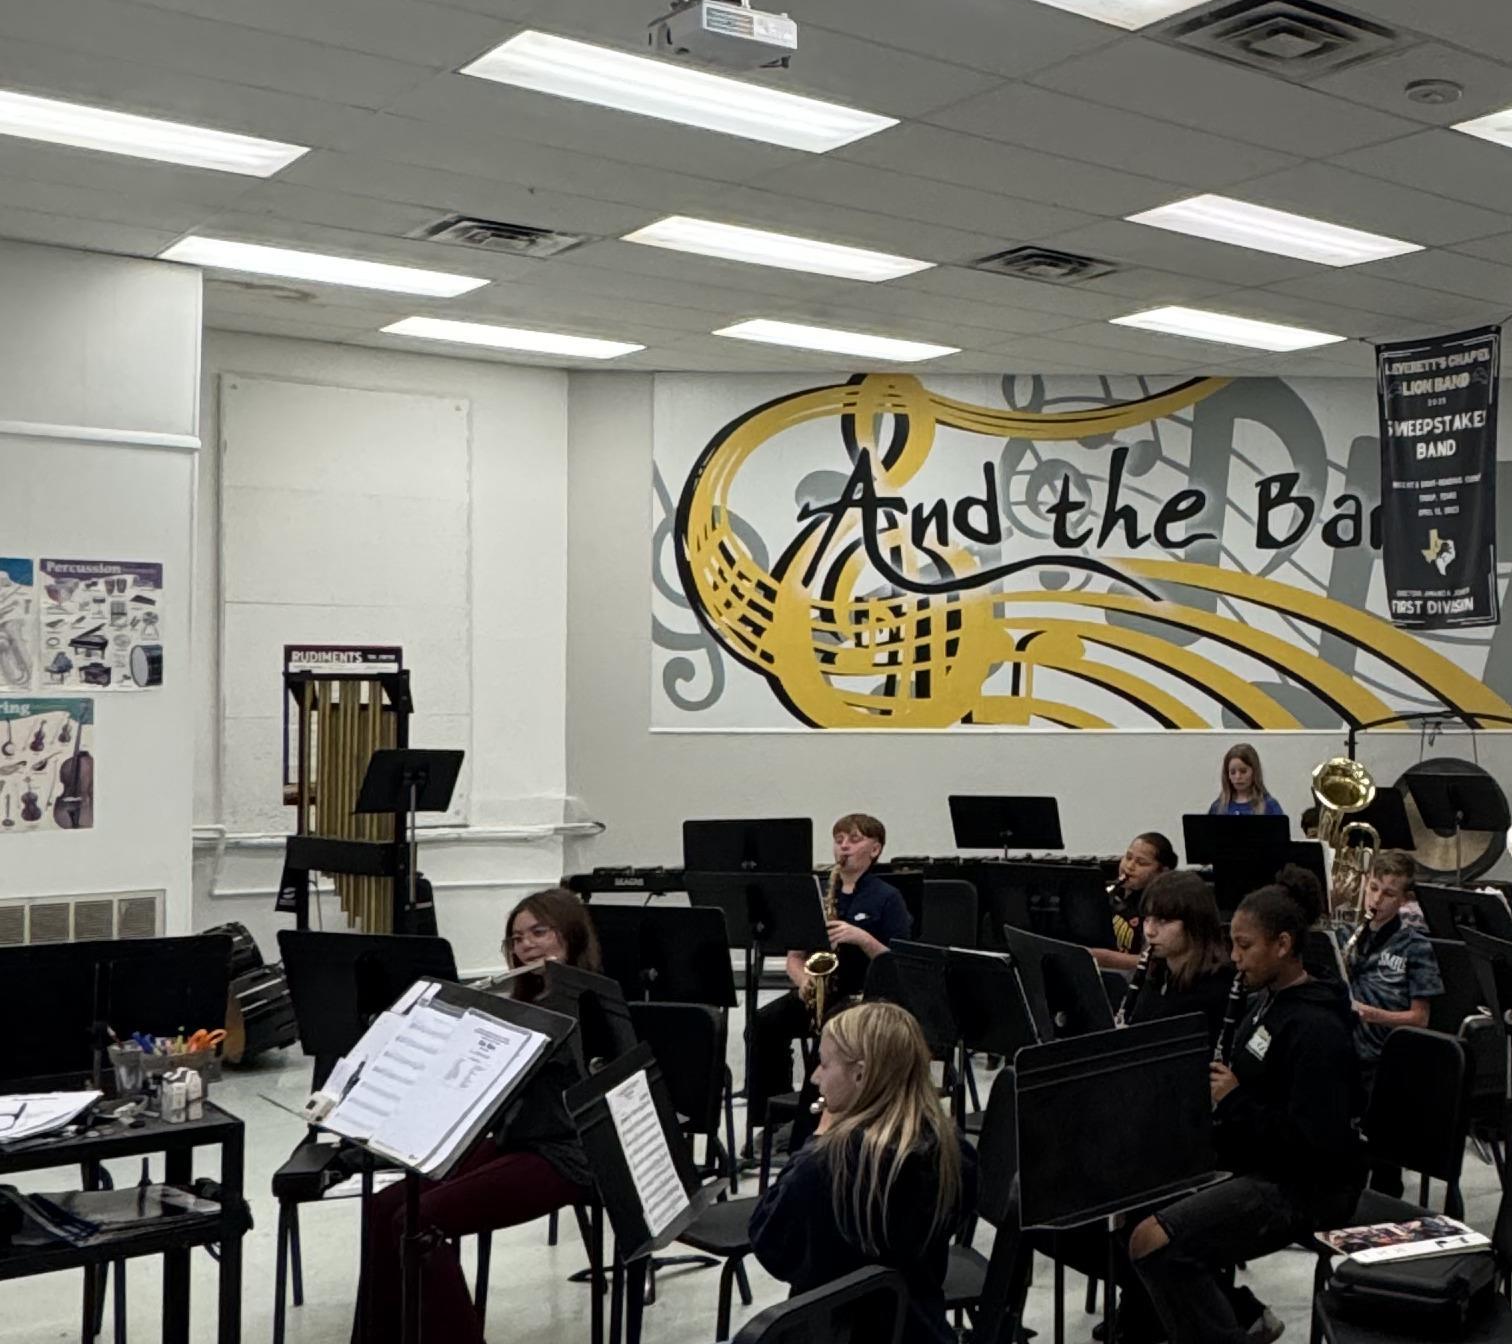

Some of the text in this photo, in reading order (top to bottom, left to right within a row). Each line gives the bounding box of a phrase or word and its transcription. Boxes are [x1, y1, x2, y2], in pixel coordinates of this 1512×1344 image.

[1448, 348, 1490, 368] CHAPEL
[1402, 372, 1470, 397] LION BAND
[1416, 439, 1457, 460] BAND
[1046, 447, 1217, 549] the
[46, 561, 122, 574] Percussion
[291, 651, 363, 663] RUDIMENTS
